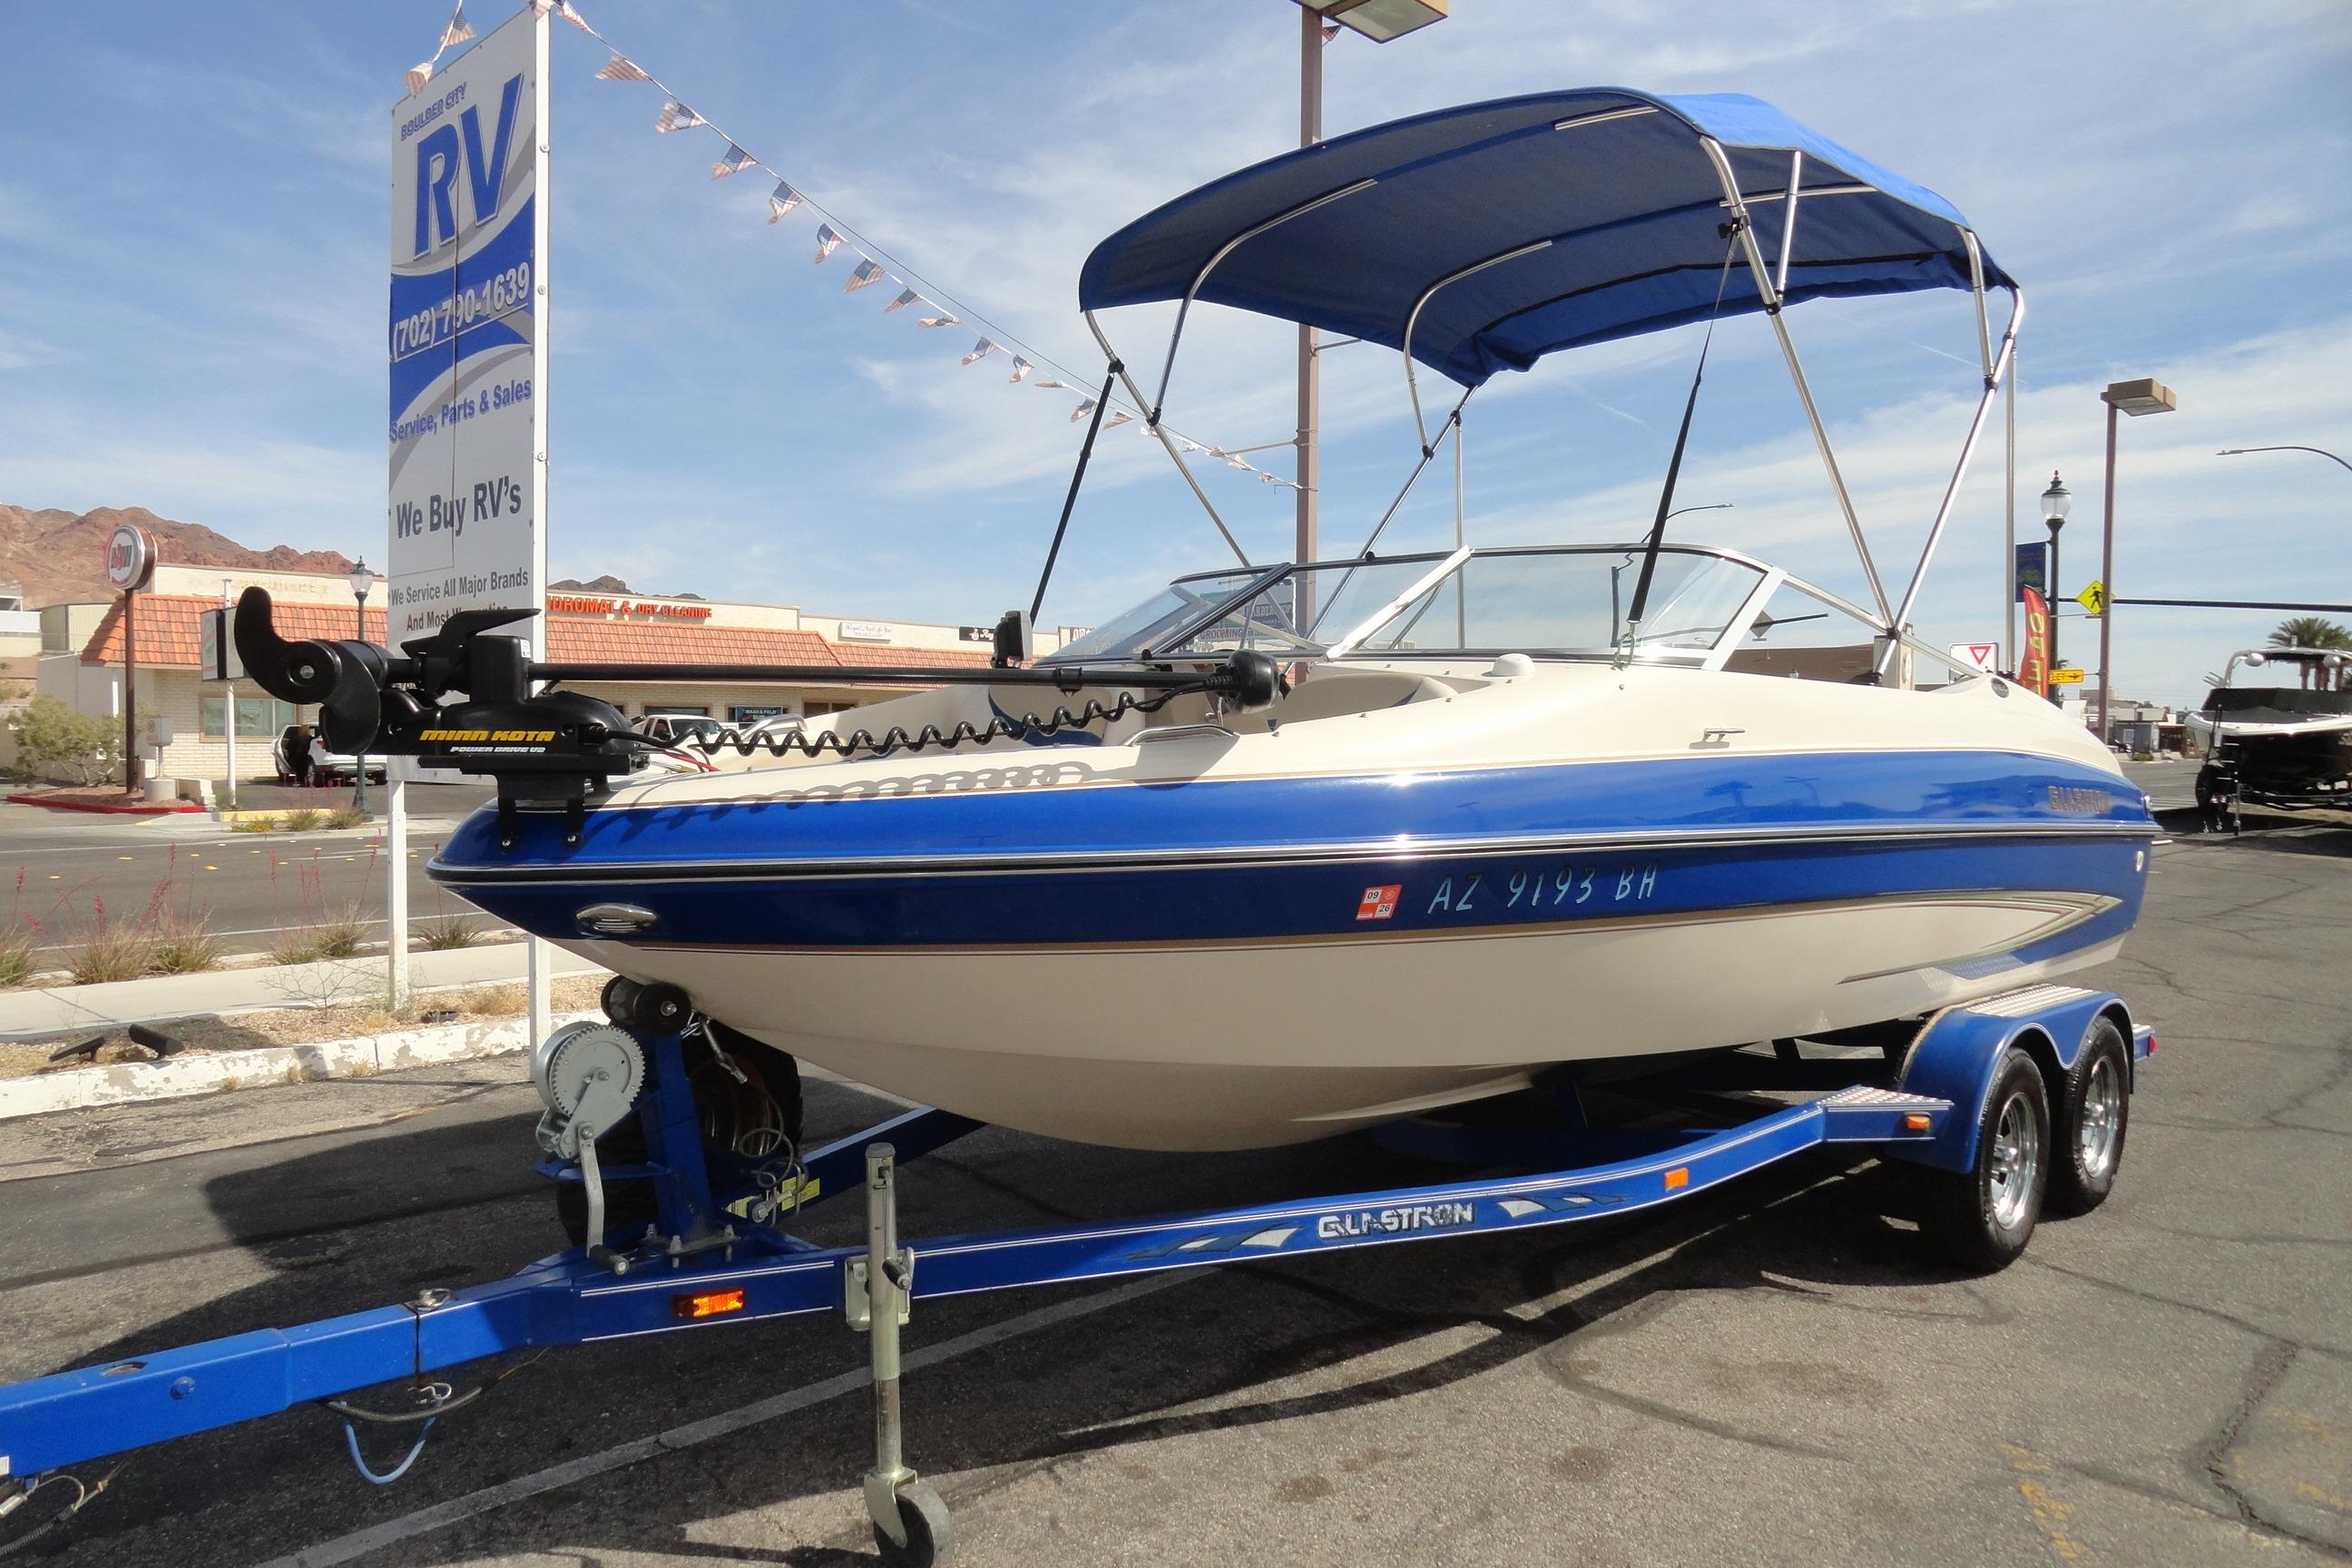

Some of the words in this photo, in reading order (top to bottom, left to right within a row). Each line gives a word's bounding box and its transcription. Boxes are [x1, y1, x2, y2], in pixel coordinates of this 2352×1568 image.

[400, 99, 444, 142] BOULDER
[445, 82, 467, 110] CITY
[413, 73, 524, 261] RV
[393, 307, 436, 362] (702)
[442, 262, 530, 333] 790-1639
[390, 414, 437, 444] Service,
[441, 397, 475, 427] Parts
[479, 389, 490, 415] &
[493, 379, 532, 409] Sales
[397, 501, 423, 538] We
[429, 494, 466, 537] Buy
[474, 475, 522, 523] RV's
[391, 588, 405, 606] We
[407, 583, 441, 603] Service
[443, 578, 456, 598] All
[459, 574, 488, 599] Major
[490, 567, 528, 591] Brands
[407, 613, 424, 632] And
[622, 600, 633, 615] &
[637, 603, 660, 615] DRY
[661, 604, 712, 618] CLEANING
[1200, 628, 1243, 640] GROOMING
[419, 730, 490, 741] MINN
[491, 730, 555, 742] KOTA
[1367, 891, 1380, 900] 09
[1506, 864, 1598, 907] 9193
[1615, 860, 1660, 901] BH
[1378, 904, 1391, 913] 26
